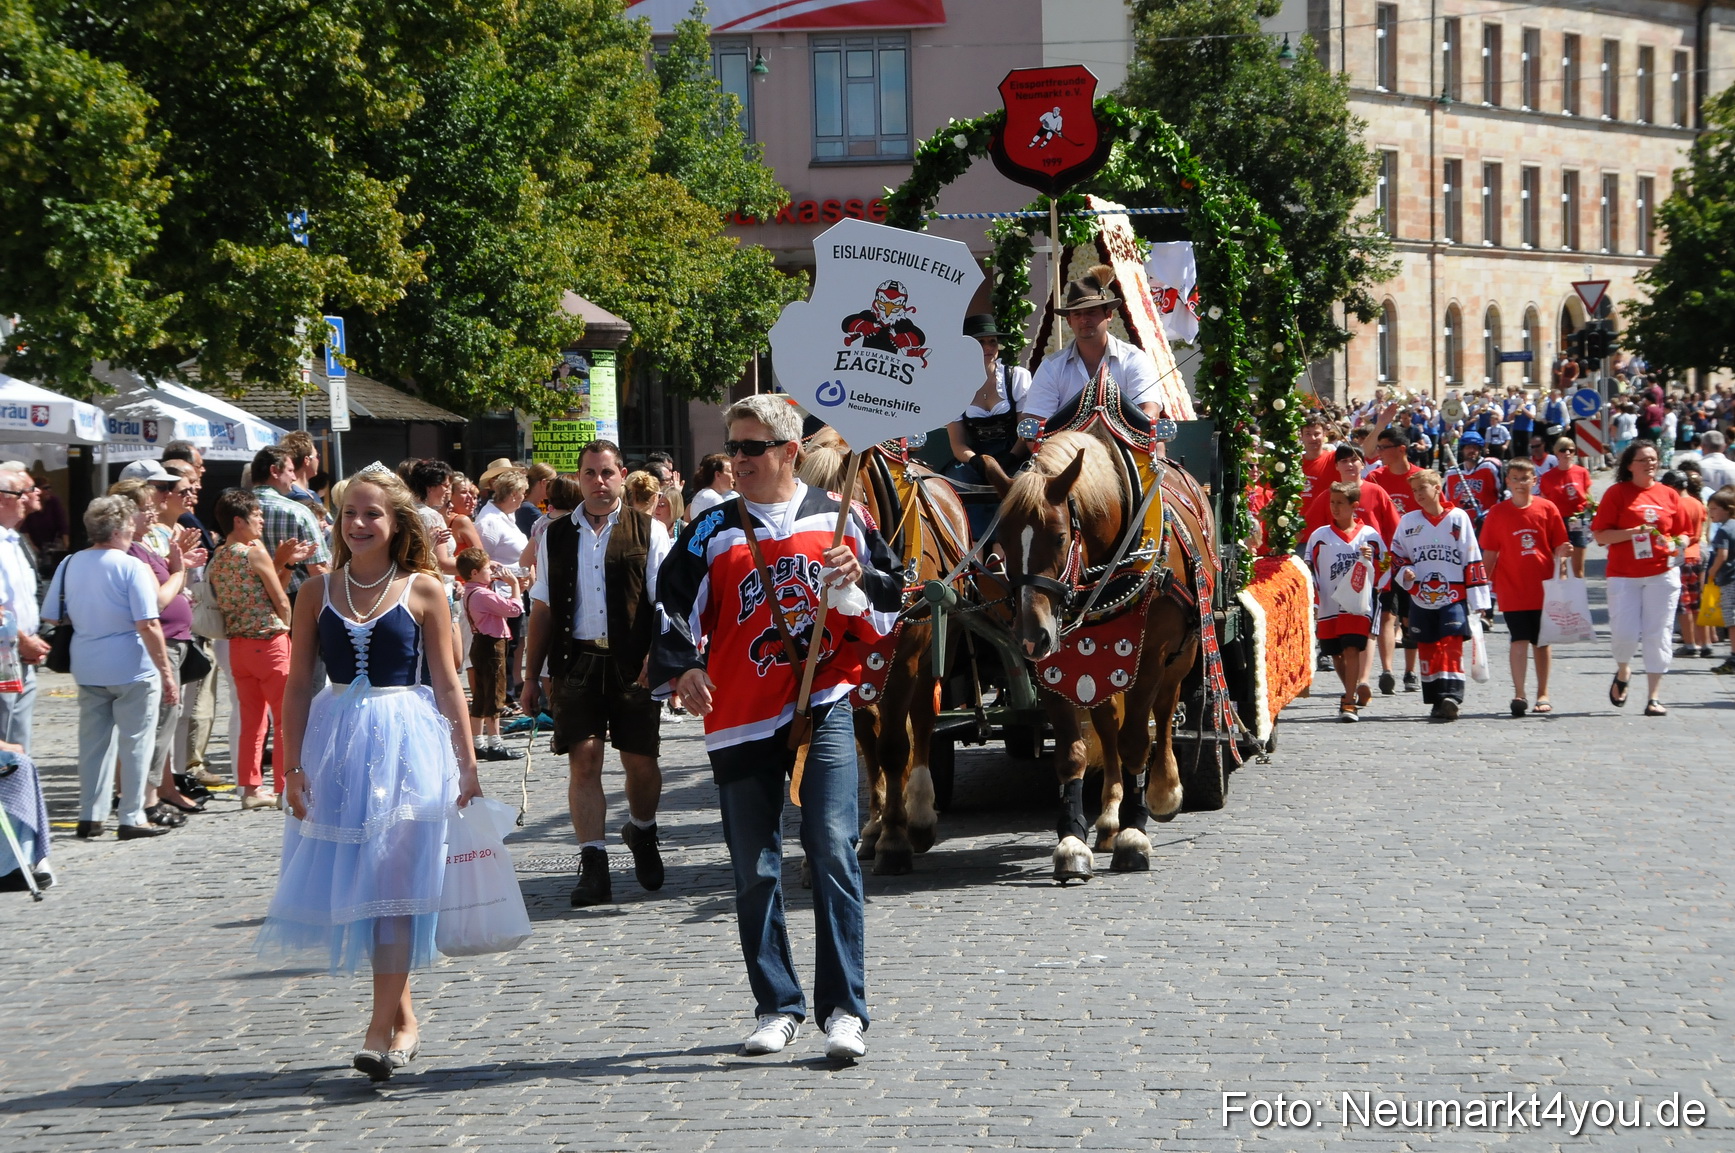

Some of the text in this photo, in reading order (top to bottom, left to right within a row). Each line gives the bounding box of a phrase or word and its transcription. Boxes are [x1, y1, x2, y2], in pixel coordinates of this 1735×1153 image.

[1009, 77, 1086, 90] Eissportfreunde
[1015, 89, 1062, 100] Neumarkt
[1042, 157, 1063, 167] 1999
[833, 245, 965, 285] EISLAUFSCHULE FELIX
[853, 350, 901, 364] NEUMARKT
[833, 350, 915, 385] EAGLES
[850, 390, 921, 414] Lebenshilfe
[0, 403, 27, 420] räu
[848, 403, 898, 418] Neumarkt e.V.
[552, 423, 577, 431] Berlin
[579, 422, 595, 431] Club
[534, 432, 596, 442] VOLKSFEST
[534, 442, 586, 451] "Afterpart
